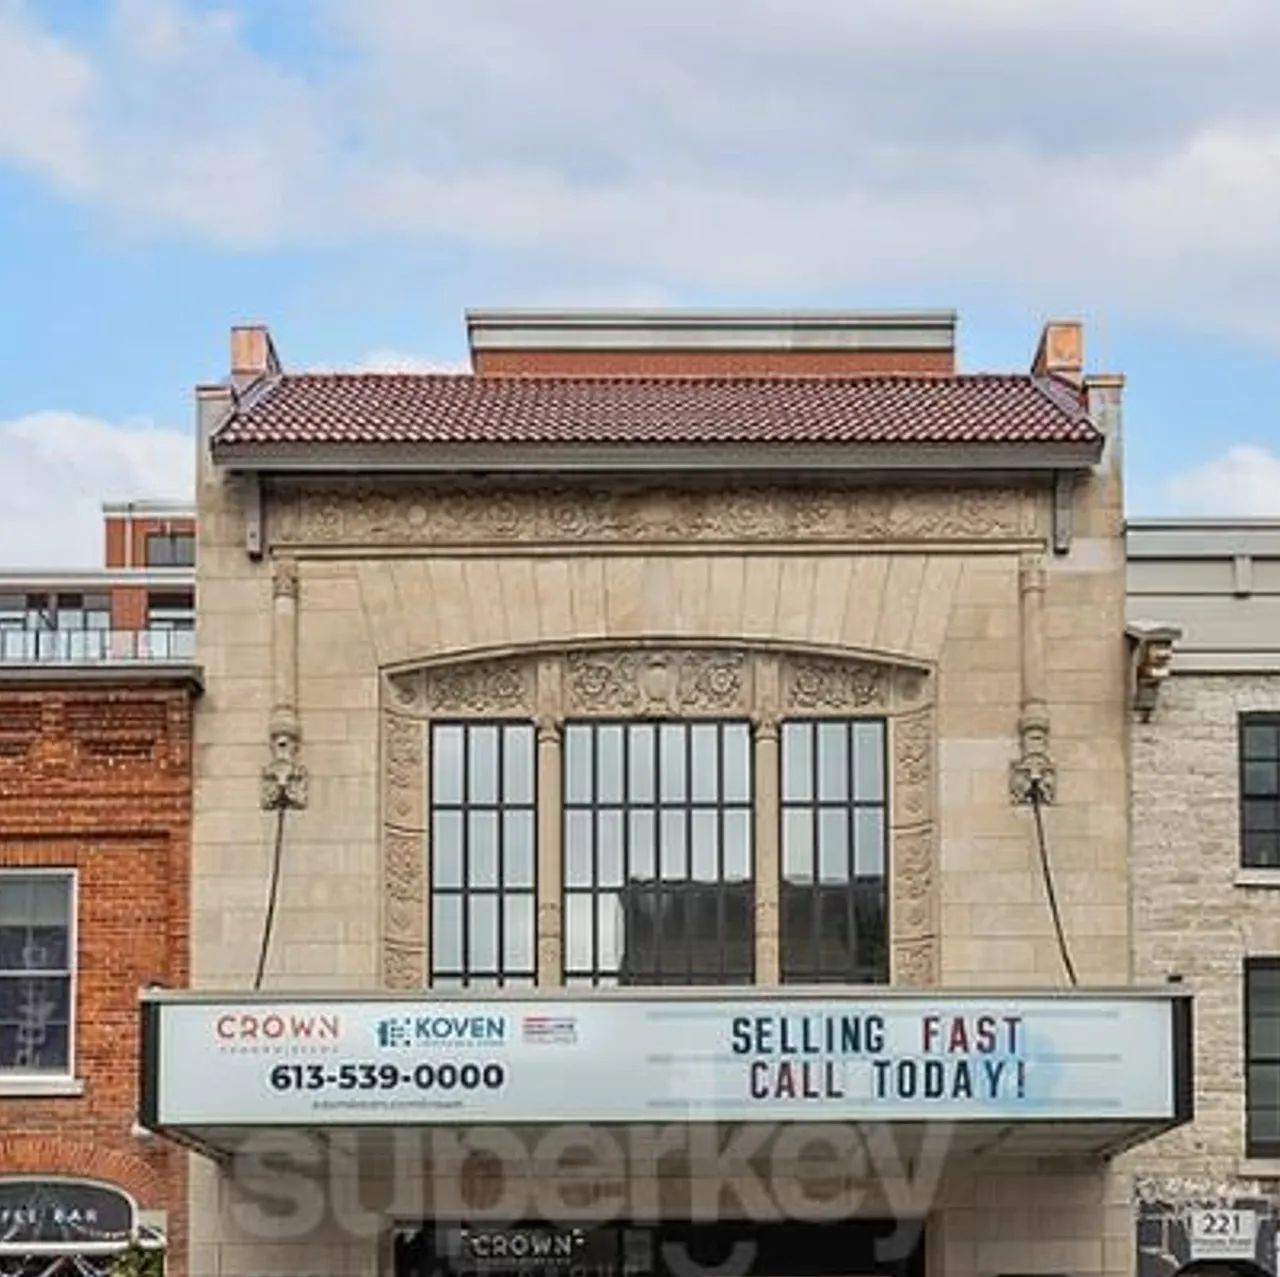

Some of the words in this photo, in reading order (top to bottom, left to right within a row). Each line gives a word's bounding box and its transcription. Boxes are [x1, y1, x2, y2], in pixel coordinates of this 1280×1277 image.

[217, 1015, 339, 1040] CROWN
[415, 1017, 505, 1039] KOVEN
[732, 1017, 885, 1054] SELLING
[922, 1017, 1022, 1054] FAST
[270, 1063, 505, 1091] 613-539-0000
[750, 1060, 844, 1099] CALL
[874, 1060, 1026, 1099] TODAY!
[53, 1209, 99, 1224] BAR
[1202, 1213, 1241, 1234] 221
[472, 1234, 572, 1256] CROWN
